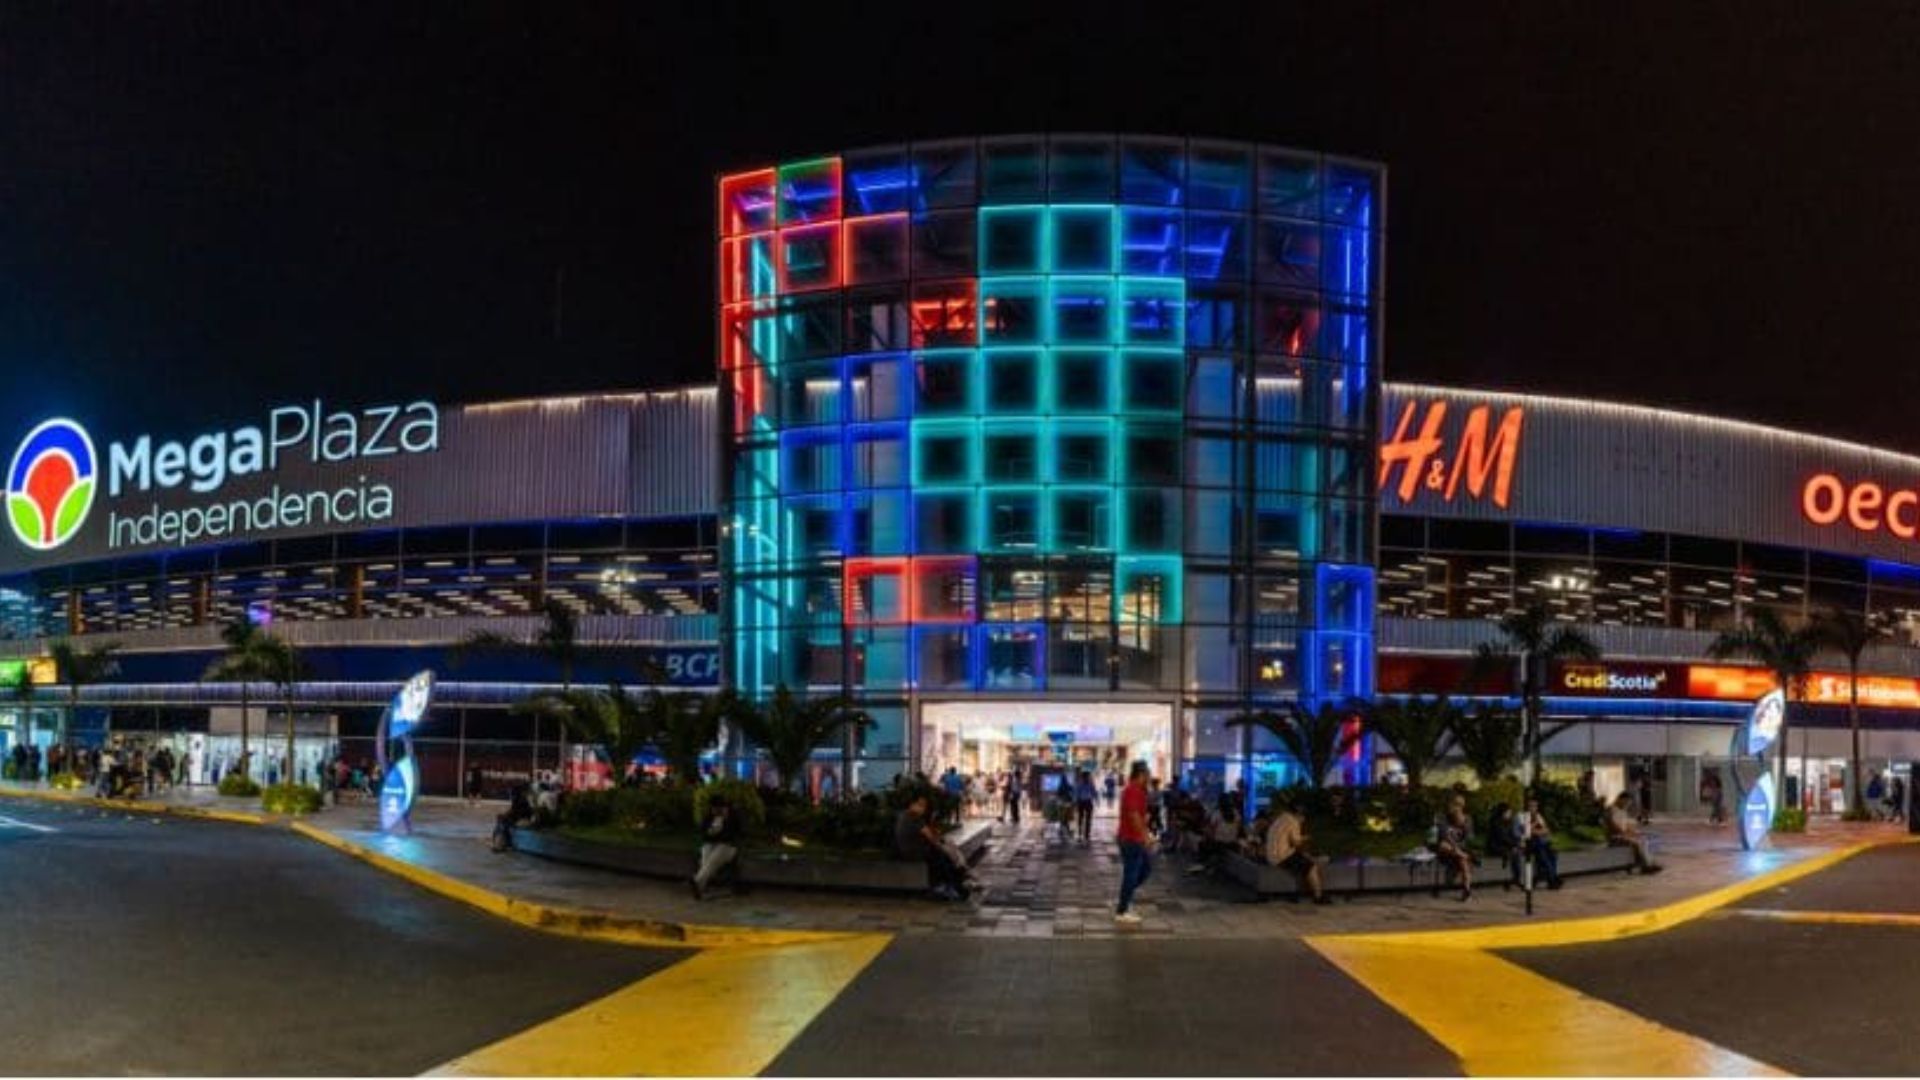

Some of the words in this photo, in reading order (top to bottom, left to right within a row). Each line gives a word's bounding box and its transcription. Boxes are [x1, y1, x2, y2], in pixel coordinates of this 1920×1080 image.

[109, 399, 438, 496] MegaPlaza
[1380, 400, 1523, 508] H&M
[109, 475, 392, 547] Independencia
